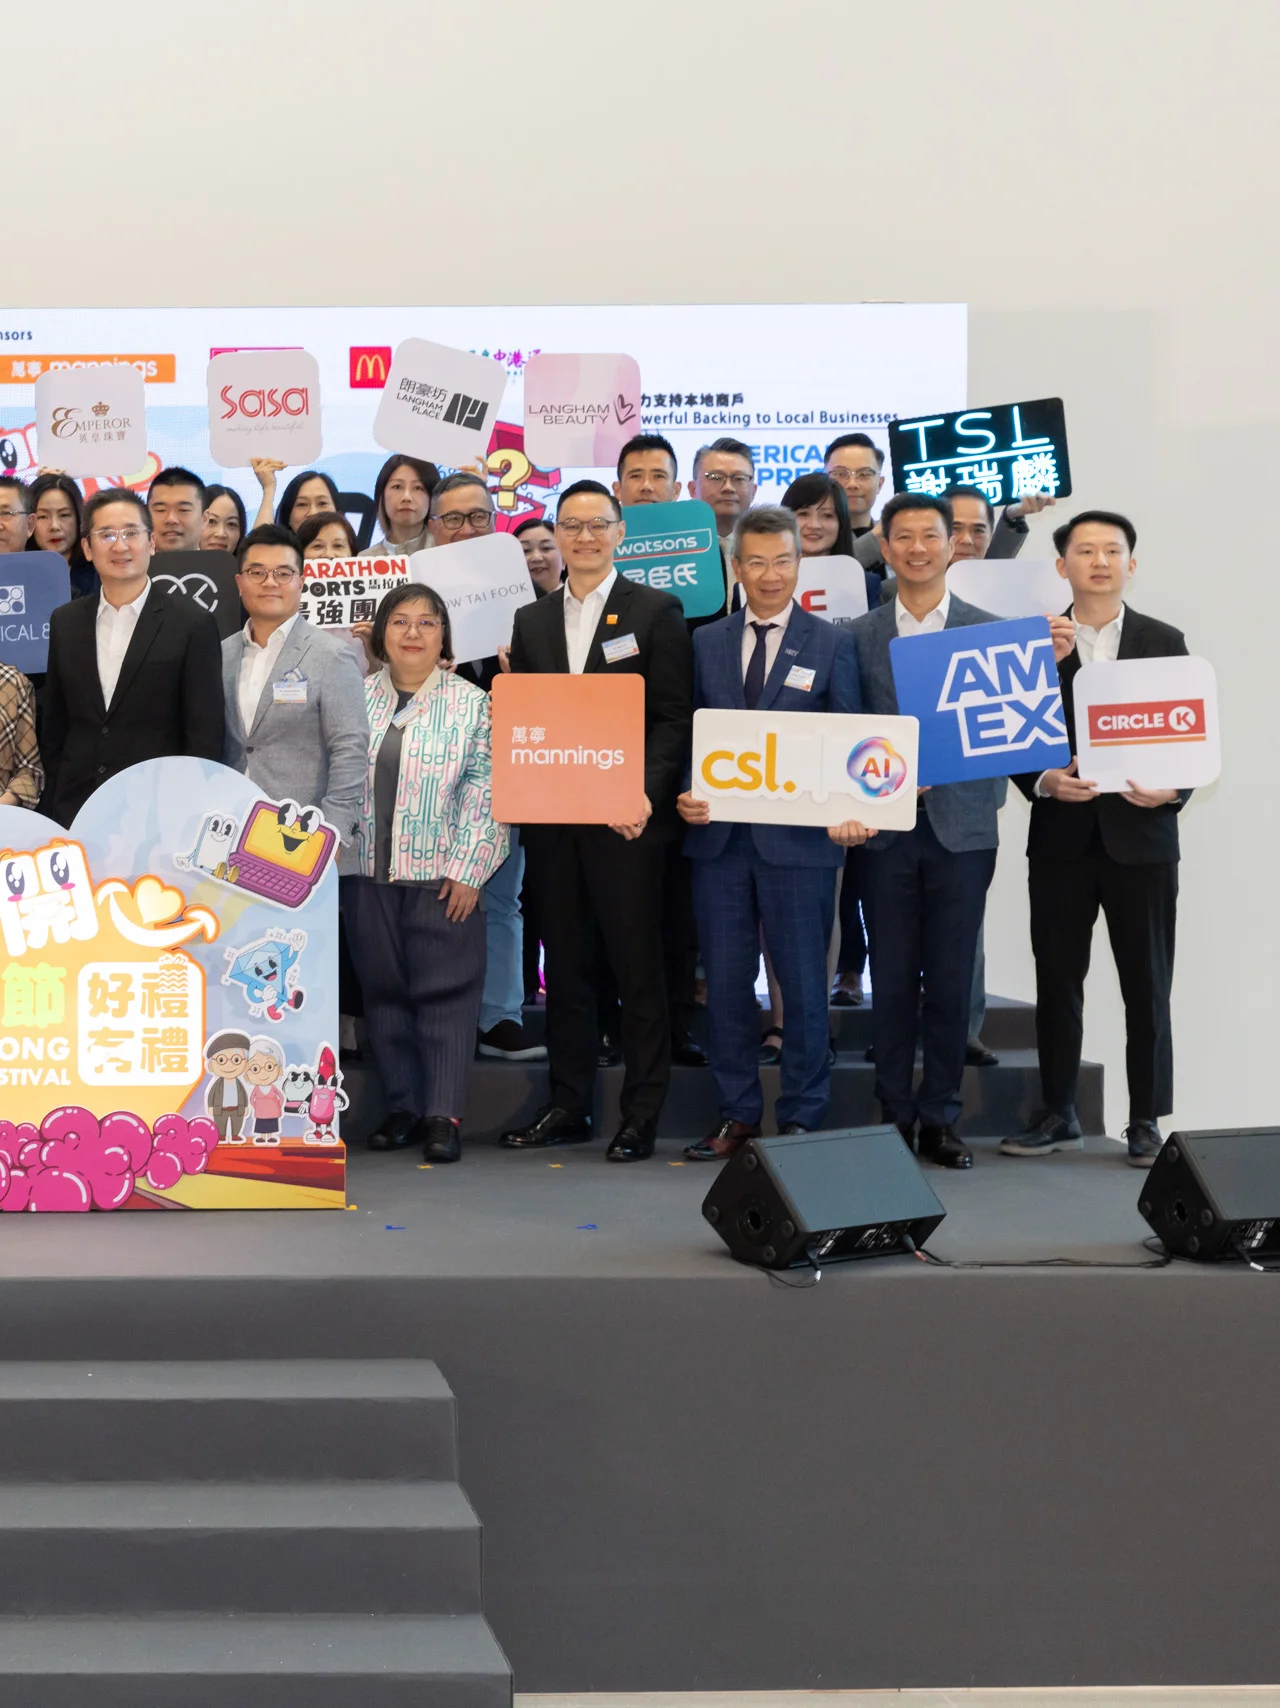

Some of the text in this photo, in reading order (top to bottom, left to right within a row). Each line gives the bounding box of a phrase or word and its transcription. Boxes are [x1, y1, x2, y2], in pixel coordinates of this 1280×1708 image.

[399, 377, 448, 402] 朗豪坊
[396, 393, 443, 411] LANGHAM
[528, 404, 610, 414] LANGHAM
[412, 406, 441, 420] PLACE
[543, 415, 609, 425] BEAUTY
[641, 410, 899, 427] werful Backing to Local Businesses
[79, 432, 126, 443] 英皇珠寶
[898, 405, 1050, 461] TSL
[904, 452, 1060, 504] 謝瑞麟
[616, 535, 698, 556] watsons
[303, 559, 407, 579] ARATHON
[302, 580, 366, 597] ORTS
[466, 593, 487, 605] TAI
[491, 582, 528, 598] FOOK
[1097, 707, 1195, 732] CIRCLE K
[511, 746, 625, 770] mannings
[861, 757, 891, 779] AI
